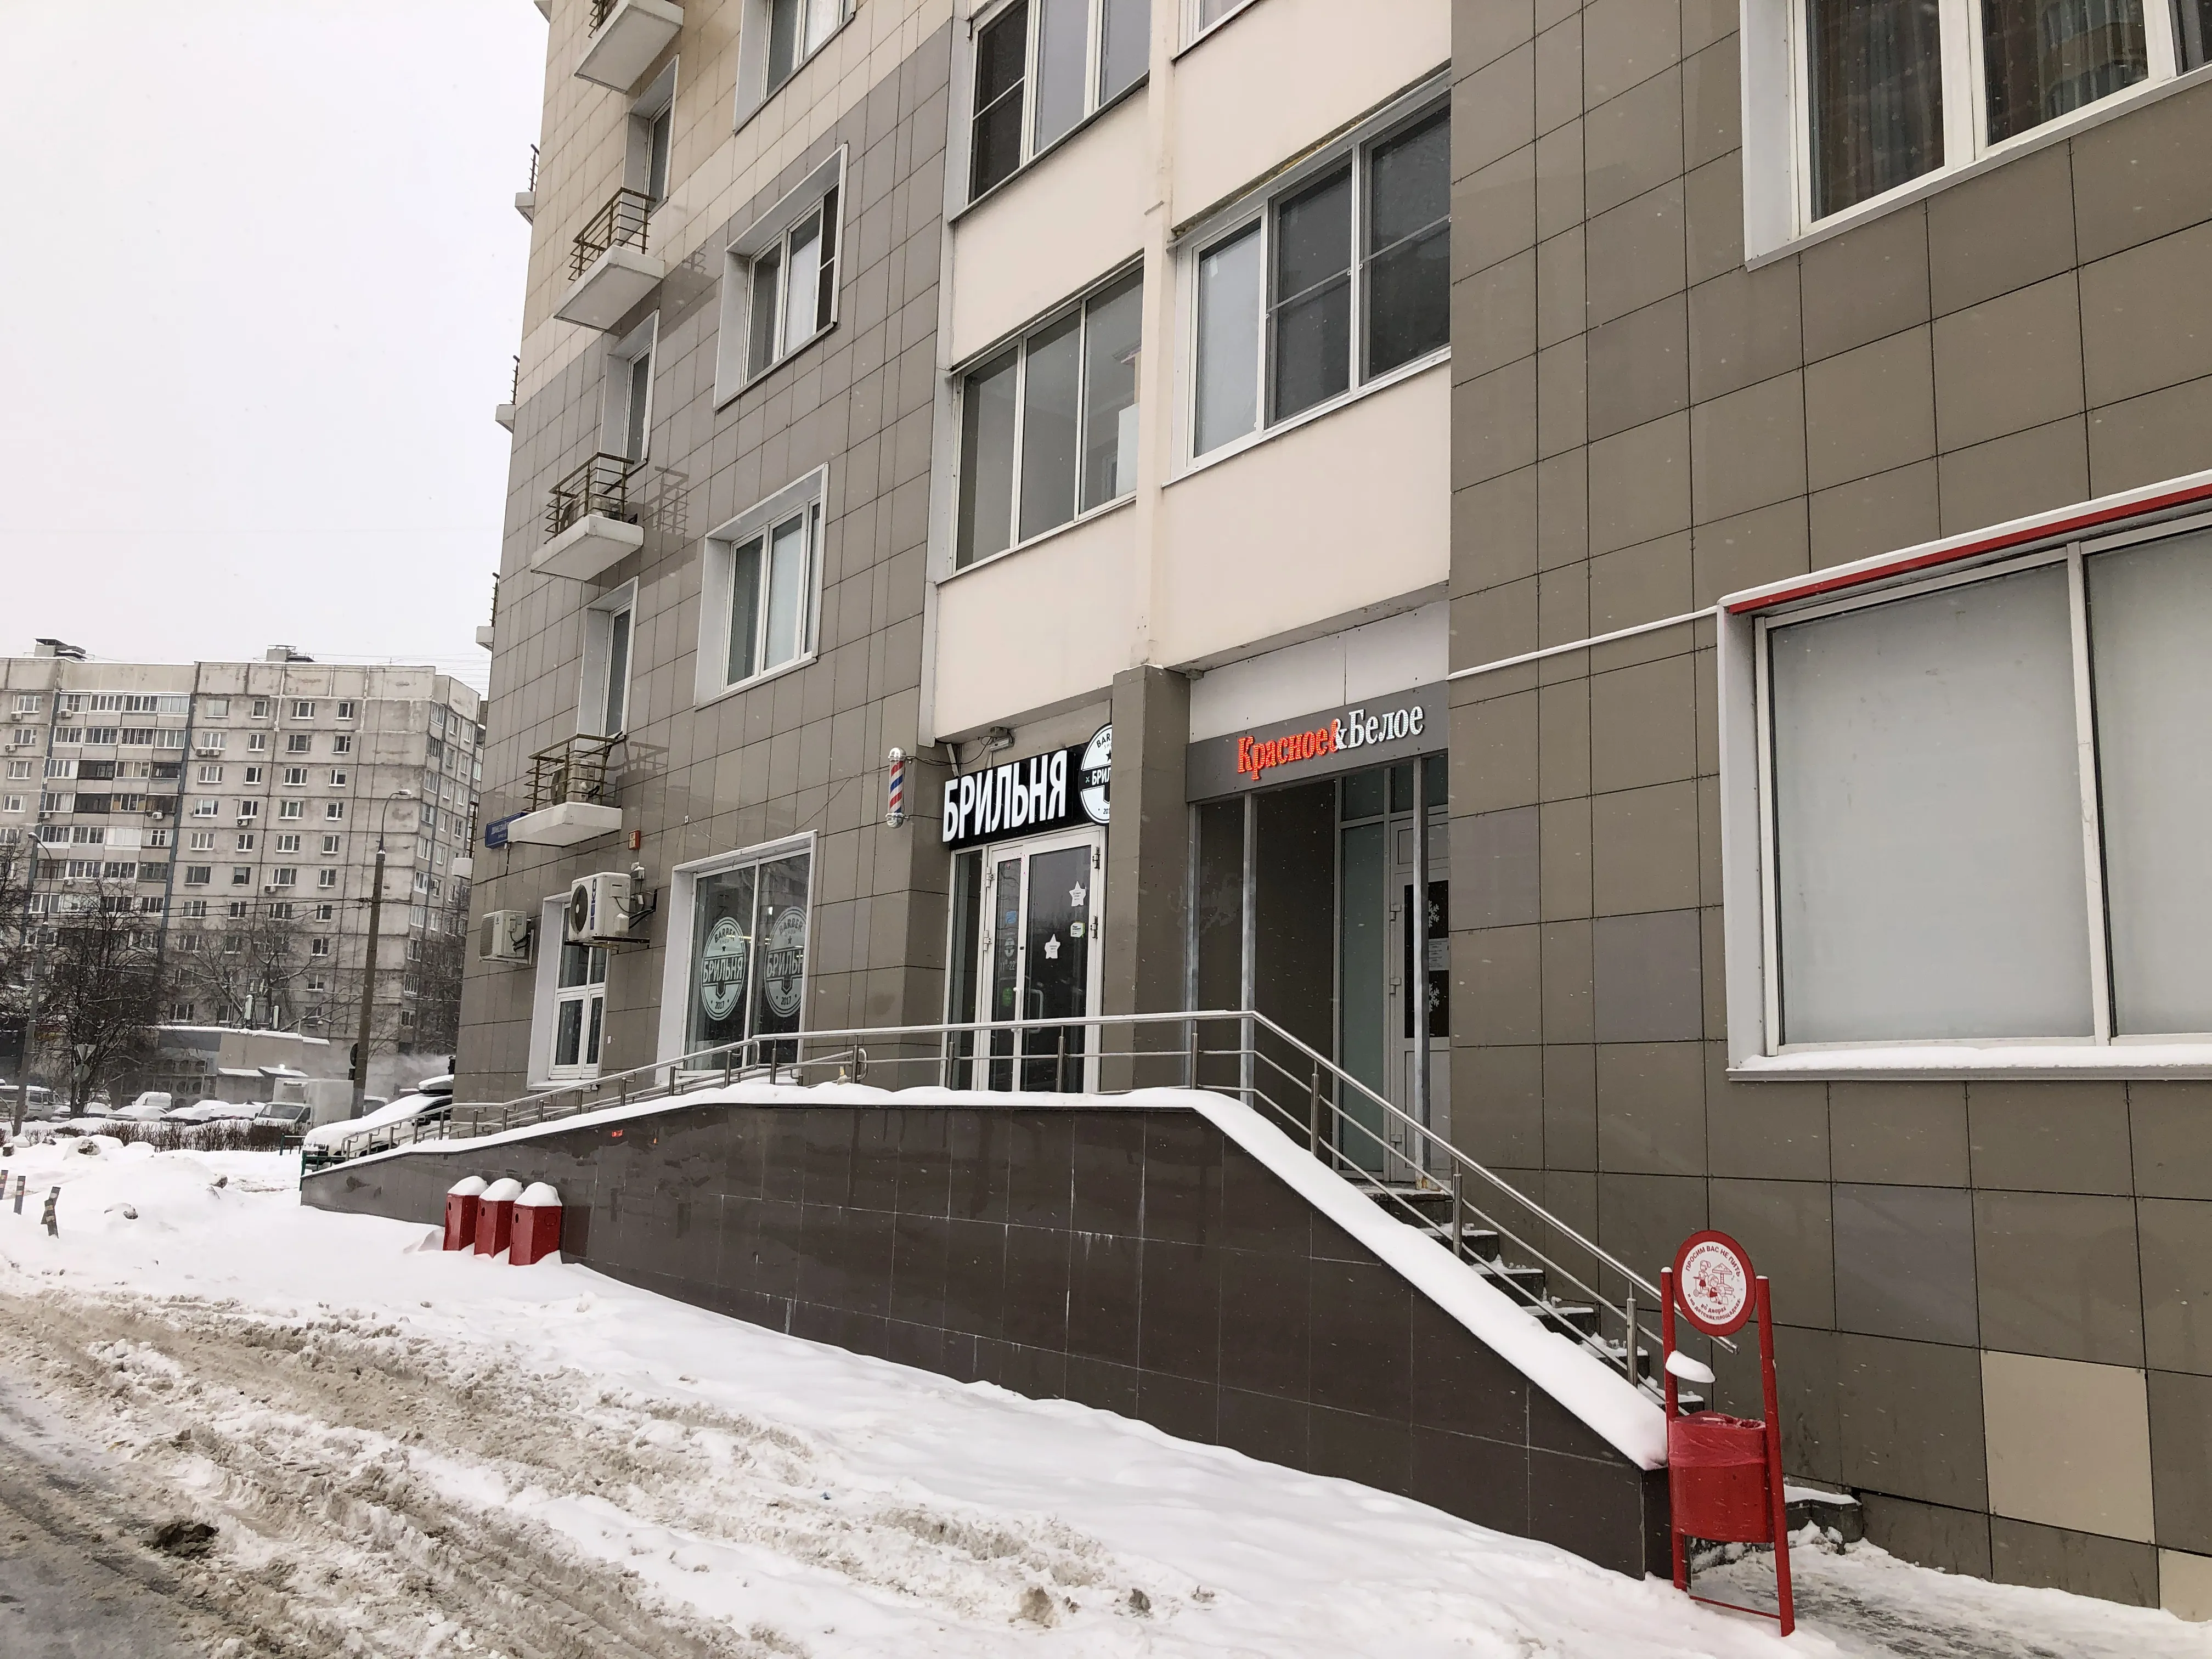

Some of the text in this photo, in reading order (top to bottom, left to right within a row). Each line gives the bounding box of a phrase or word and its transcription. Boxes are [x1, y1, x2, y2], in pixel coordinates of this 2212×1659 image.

[1097, 733, 1110, 748] BAR
[943, 750, 1068, 843] БРИЛЬНЯ
[715, 927, 735, 943] BARBER
[779, 918, 803, 935] BARBER
[702, 957, 743, 983] БРИЛЬНЯ
[766, 950, 804, 978] БРИЛЬН
[715, 1001, 725, 1009] 2017
[781, 996, 792, 1006] 2017
[1685, 1246, 1706, 1272] ПРОСИМ
[1720, 1249, 1729, 1259] НЕ
[1728, 1256, 1741, 1277] ПИТЬ
